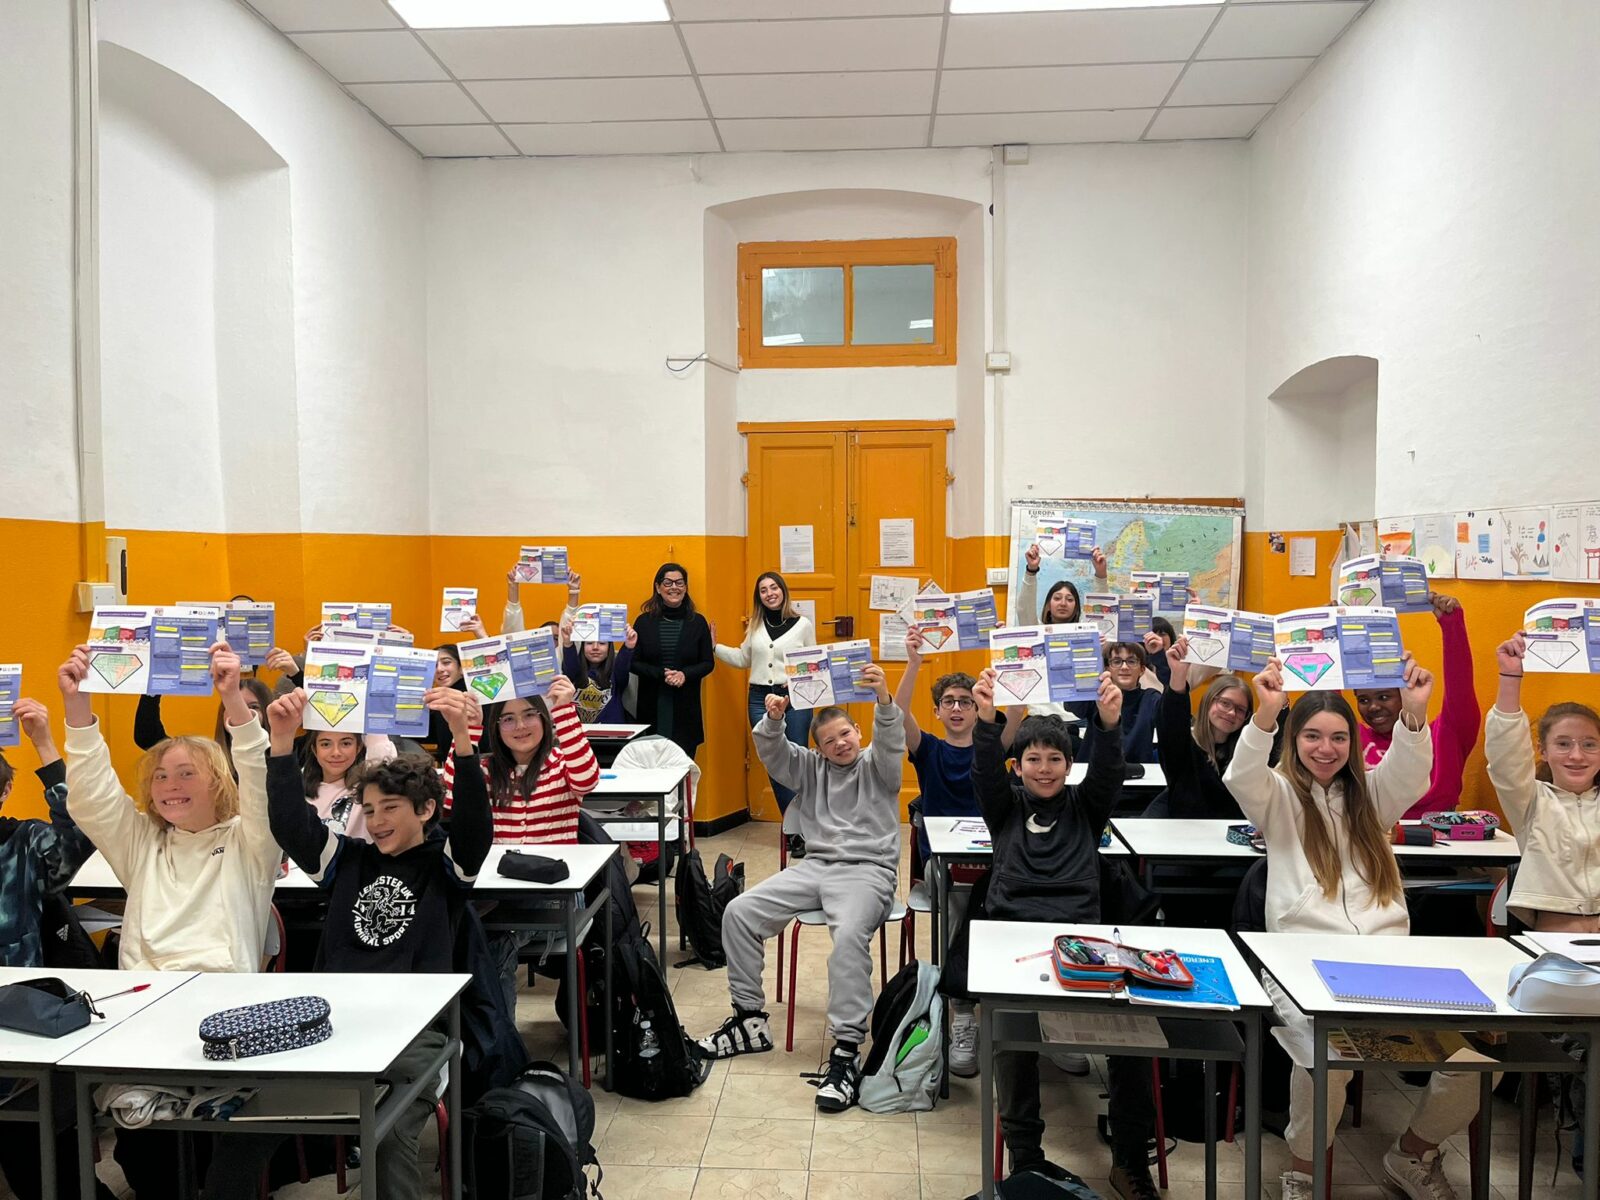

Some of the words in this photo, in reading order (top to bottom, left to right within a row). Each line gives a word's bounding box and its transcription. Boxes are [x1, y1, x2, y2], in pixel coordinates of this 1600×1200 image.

[400, 886, 414, 900] UK
[354, 915, 380, 947] ADMIRAL
[382, 920, 410, 946] SPORT
